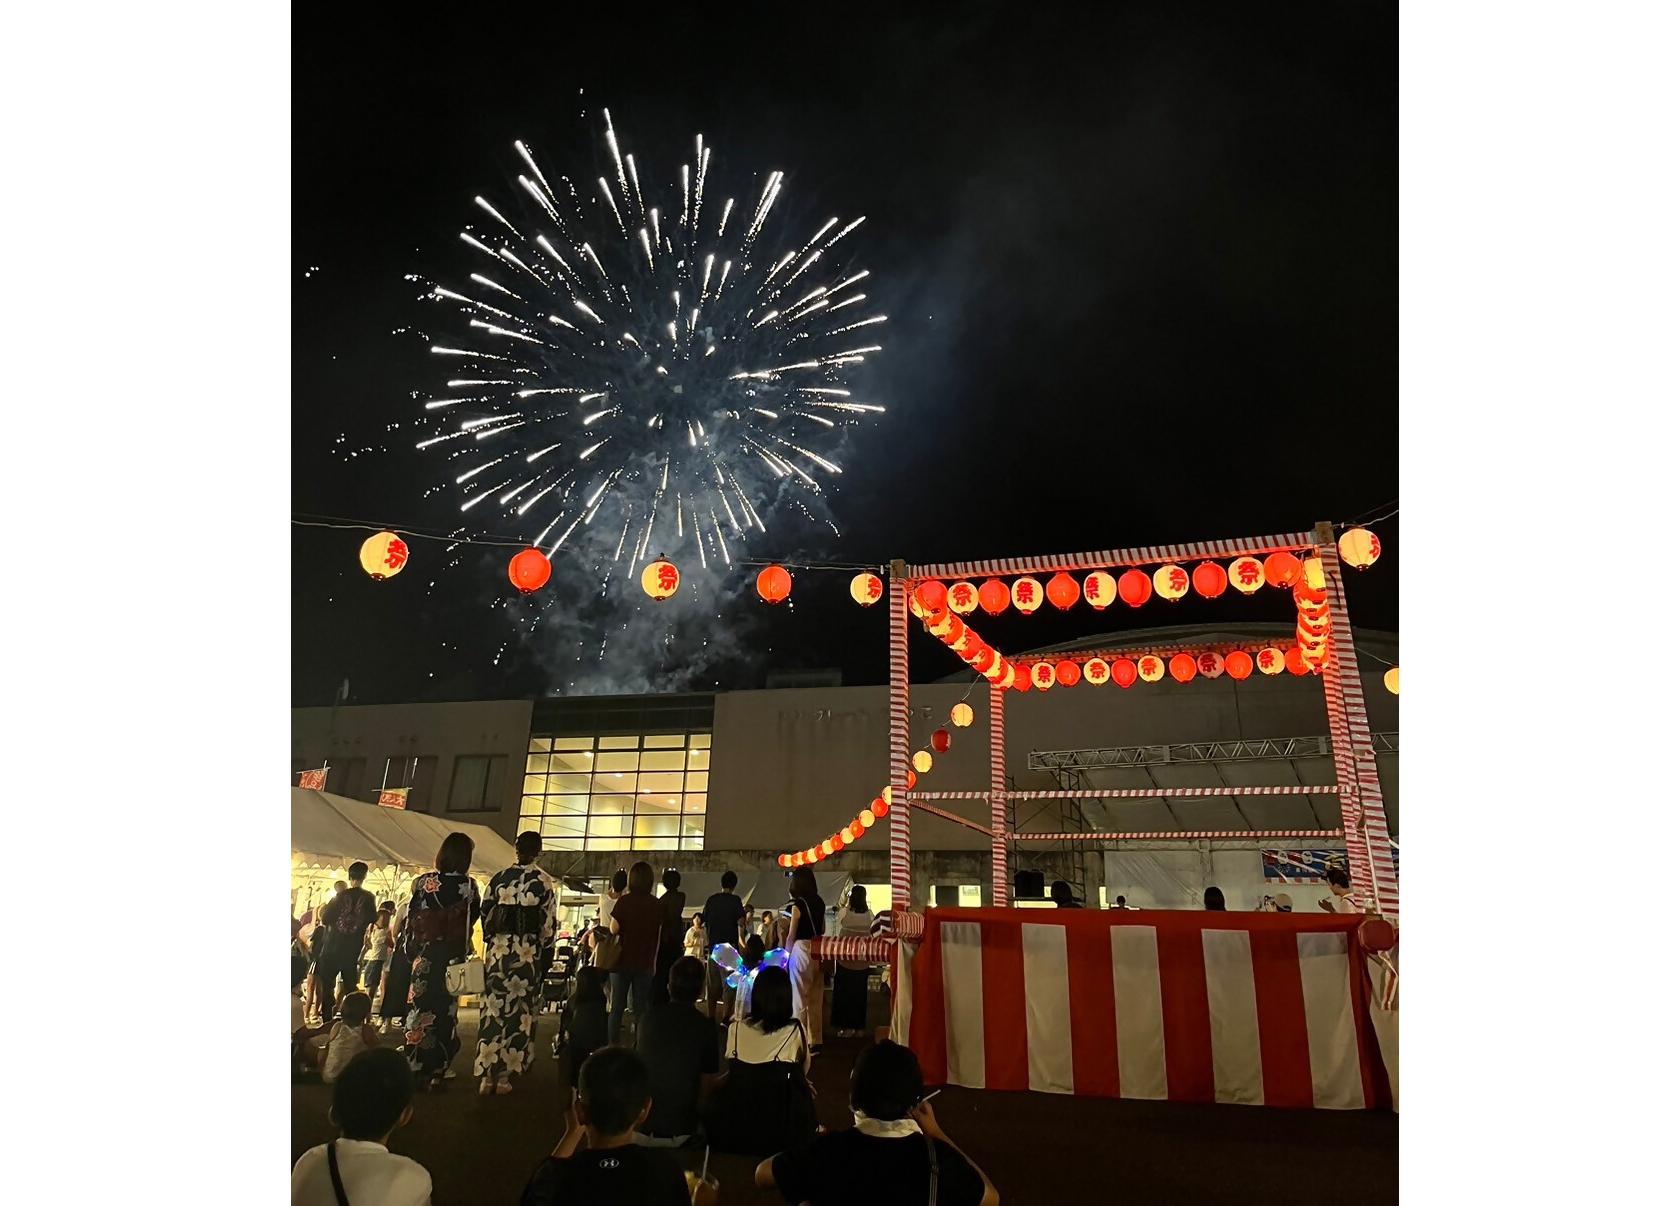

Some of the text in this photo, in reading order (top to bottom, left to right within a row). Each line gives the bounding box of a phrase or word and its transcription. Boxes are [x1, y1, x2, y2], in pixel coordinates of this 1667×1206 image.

[658, 564, 677, 591] 祭
[1169, 569, 1186, 591] 祭
[1238, 562, 1259, 584] 祭
[953, 585, 972, 606] 祭
[1017, 582, 1034, 602] 祭
[1142, 658, 1155, 675] 祭
[1200, 653, 1217, 673] 祭
[1259, 651, 1275, 668] 祭
[1039, 666, 1051, 682] 祭
[1090, 662, 1104, 679] 祭
